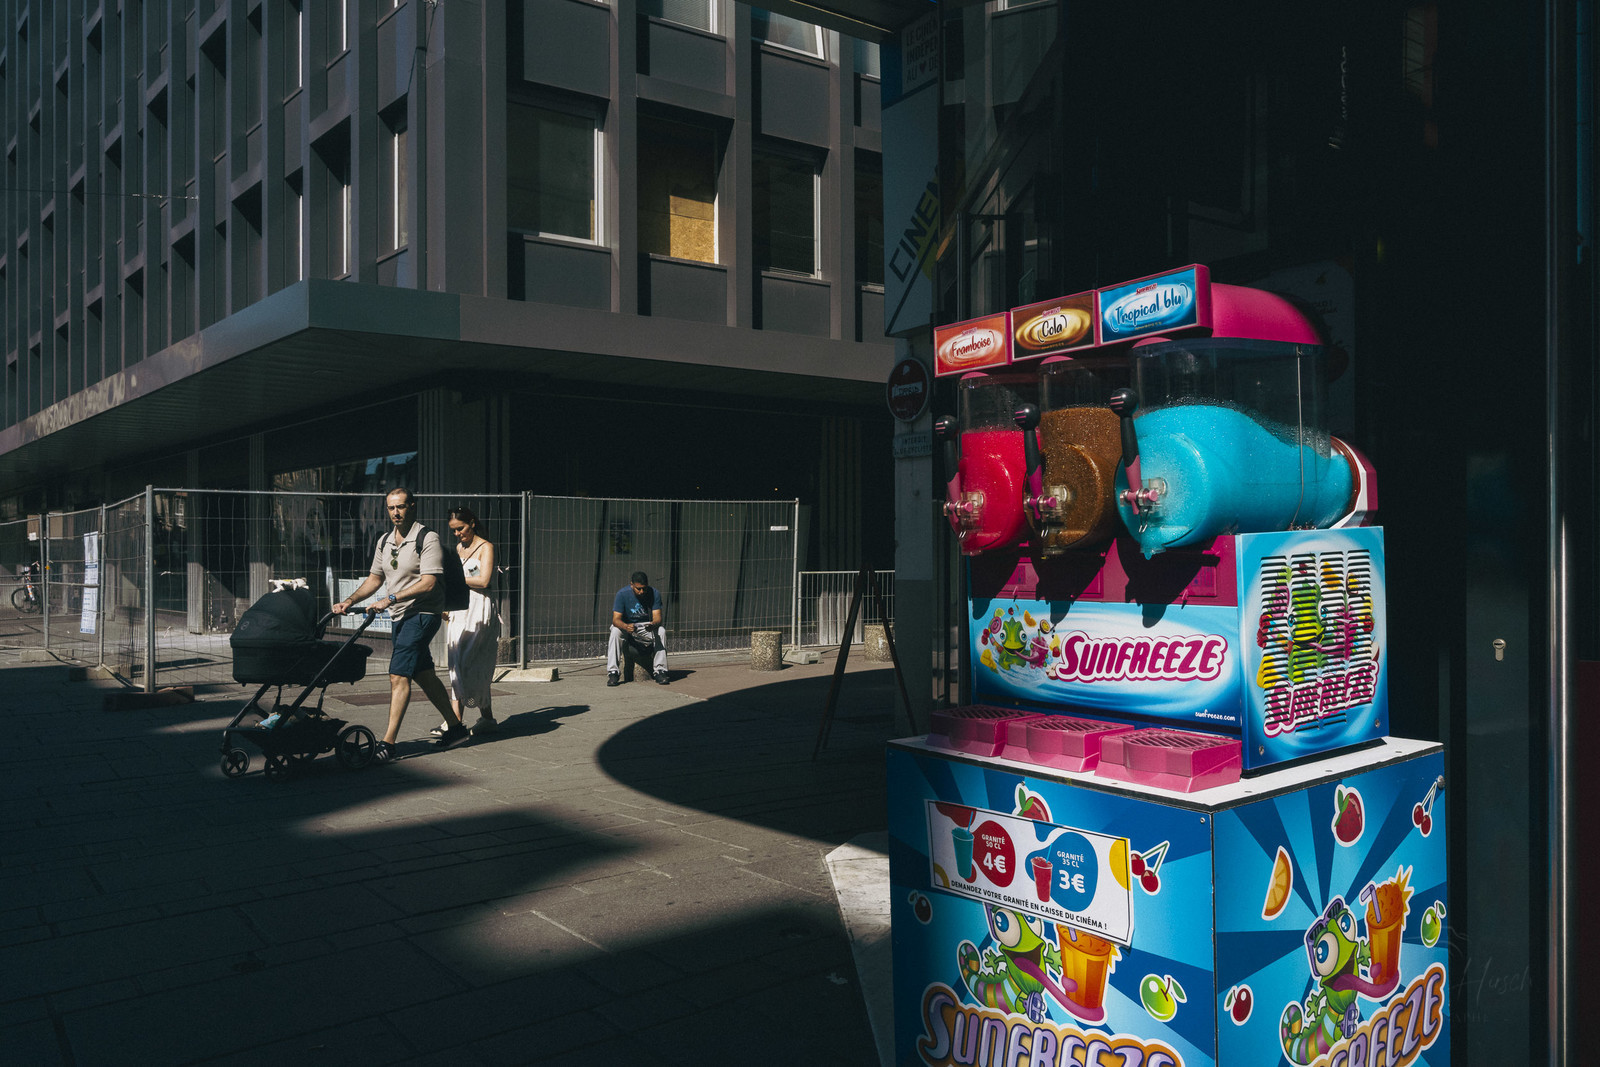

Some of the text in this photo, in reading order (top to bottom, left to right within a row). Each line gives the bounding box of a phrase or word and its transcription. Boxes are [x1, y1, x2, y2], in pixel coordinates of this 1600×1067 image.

[1115, 293, 1160, 326] Tropical
[1163, 287, 1182, 309] blu
[1042, 317, 1063, 338] Cola
[951, 335, 992, 358] Framboise
[1058, 634, 1222, 677] SUNFREEZE
[1194, 708, 1236, 722] sunfreeze.com
[981, 833, 1006, 845] GRANITÉ
[985, 840, 1002, 850] 50 CL
[982, 852, 1007, 874] 4€
[1056, 850, 1085, 863] GRANITÉ
[1062, 858, 1080, 869] 35 CL
[1058, 869, 1086, 894] 3€
[951, 880, 982, 895] DEMANDEZ
[982, 889, 1002, 901] VOTRE
[1003, 894, 1030, 908] GRANITÉ
[1030, 902, 1040, 911] EN
[1040, 904, 1064, 918] CAISSE
[1065, 911, 1075, 921] DU
[1075, 913, 1103, 930] CINÉMA
[925, 990, 1176, 1067] SUNFREE
